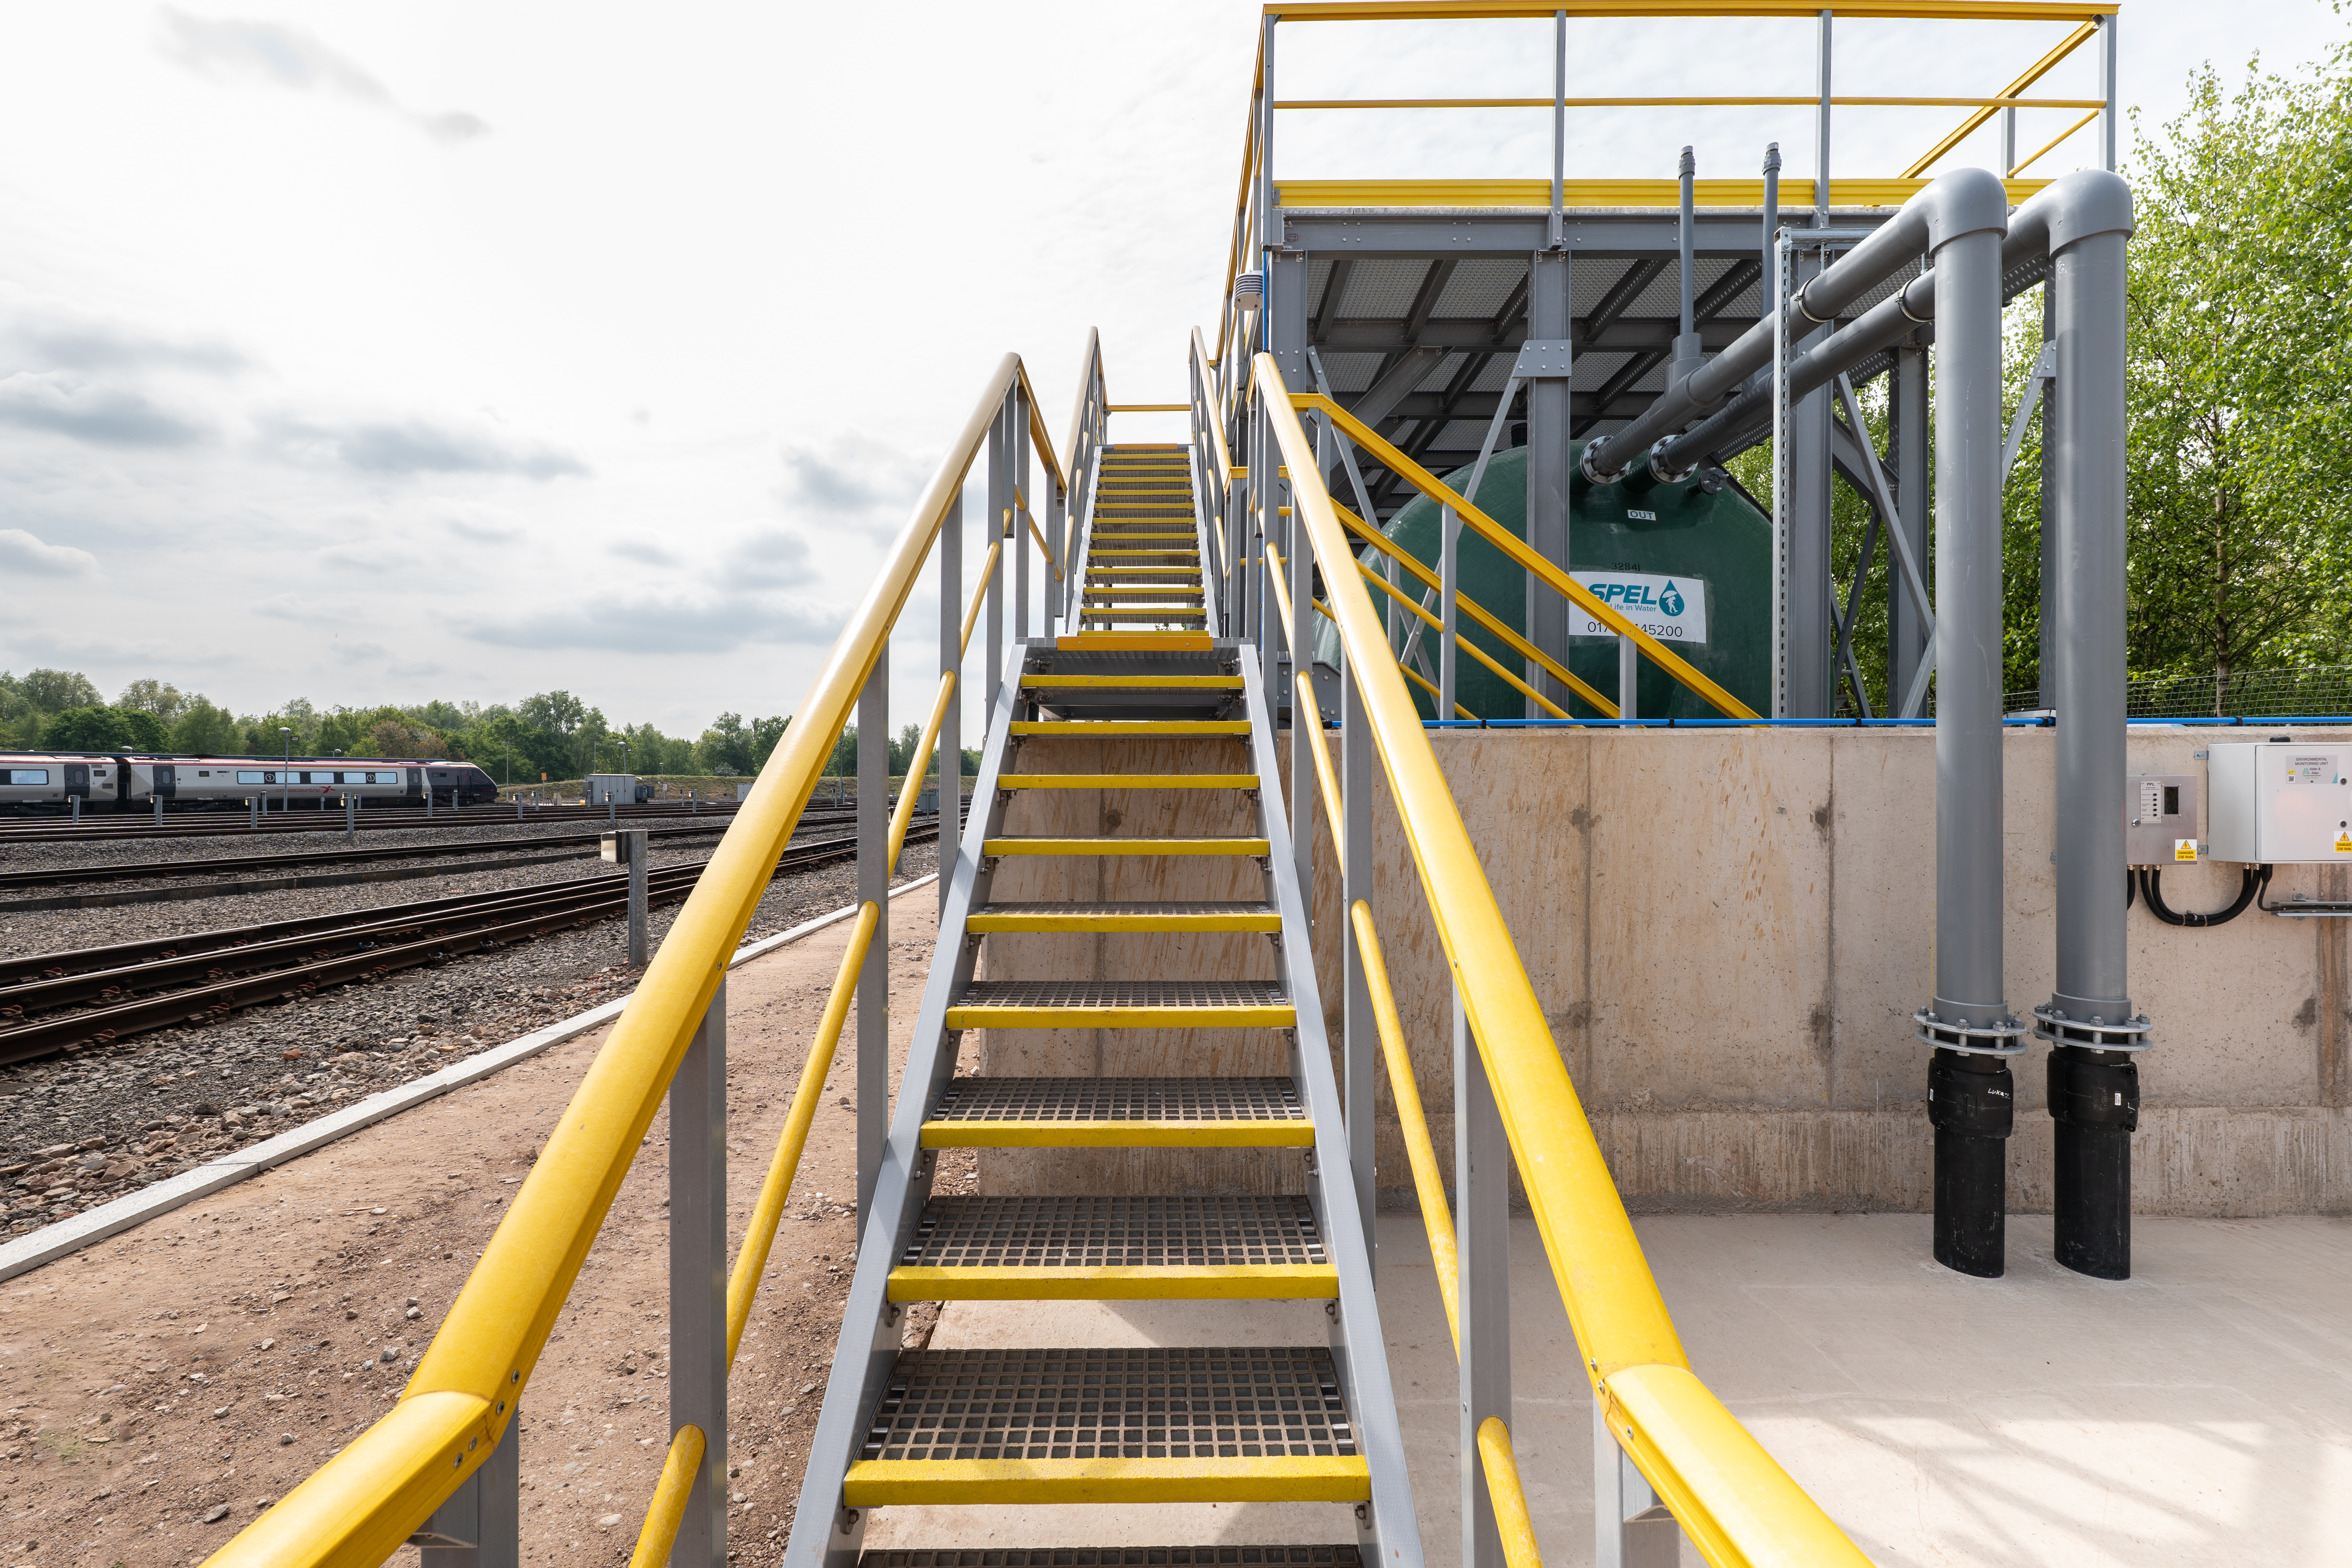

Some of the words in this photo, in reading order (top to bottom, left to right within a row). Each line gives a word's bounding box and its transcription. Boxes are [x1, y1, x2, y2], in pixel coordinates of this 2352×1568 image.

[1630, 511, 1653, 519] OUT
[1588, 584, 1657, 605] SPEL
[1635, 623, 1682, 637] 45200
